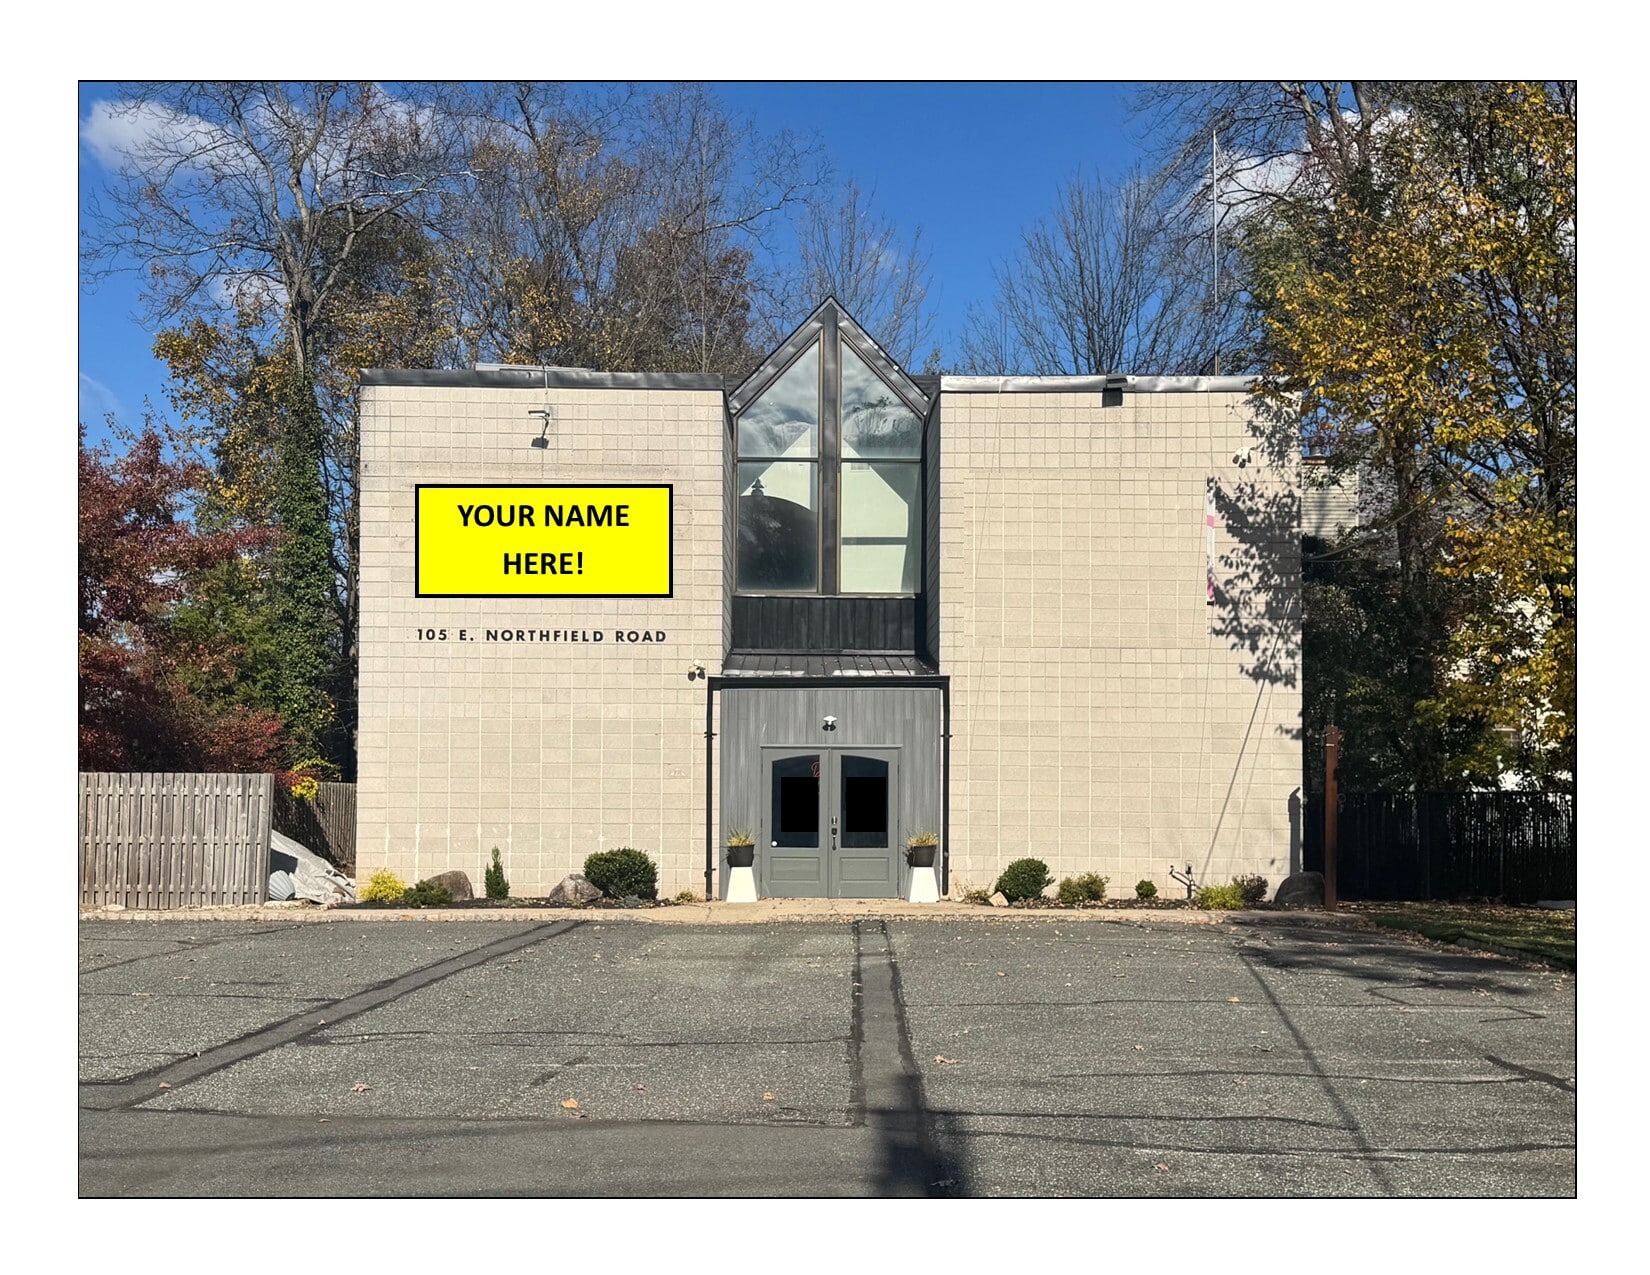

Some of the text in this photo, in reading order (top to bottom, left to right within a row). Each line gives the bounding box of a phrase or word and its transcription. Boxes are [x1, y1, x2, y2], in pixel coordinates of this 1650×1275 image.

[417, 628, 666, 643] 105 E. NORTHFIELD ROAD
